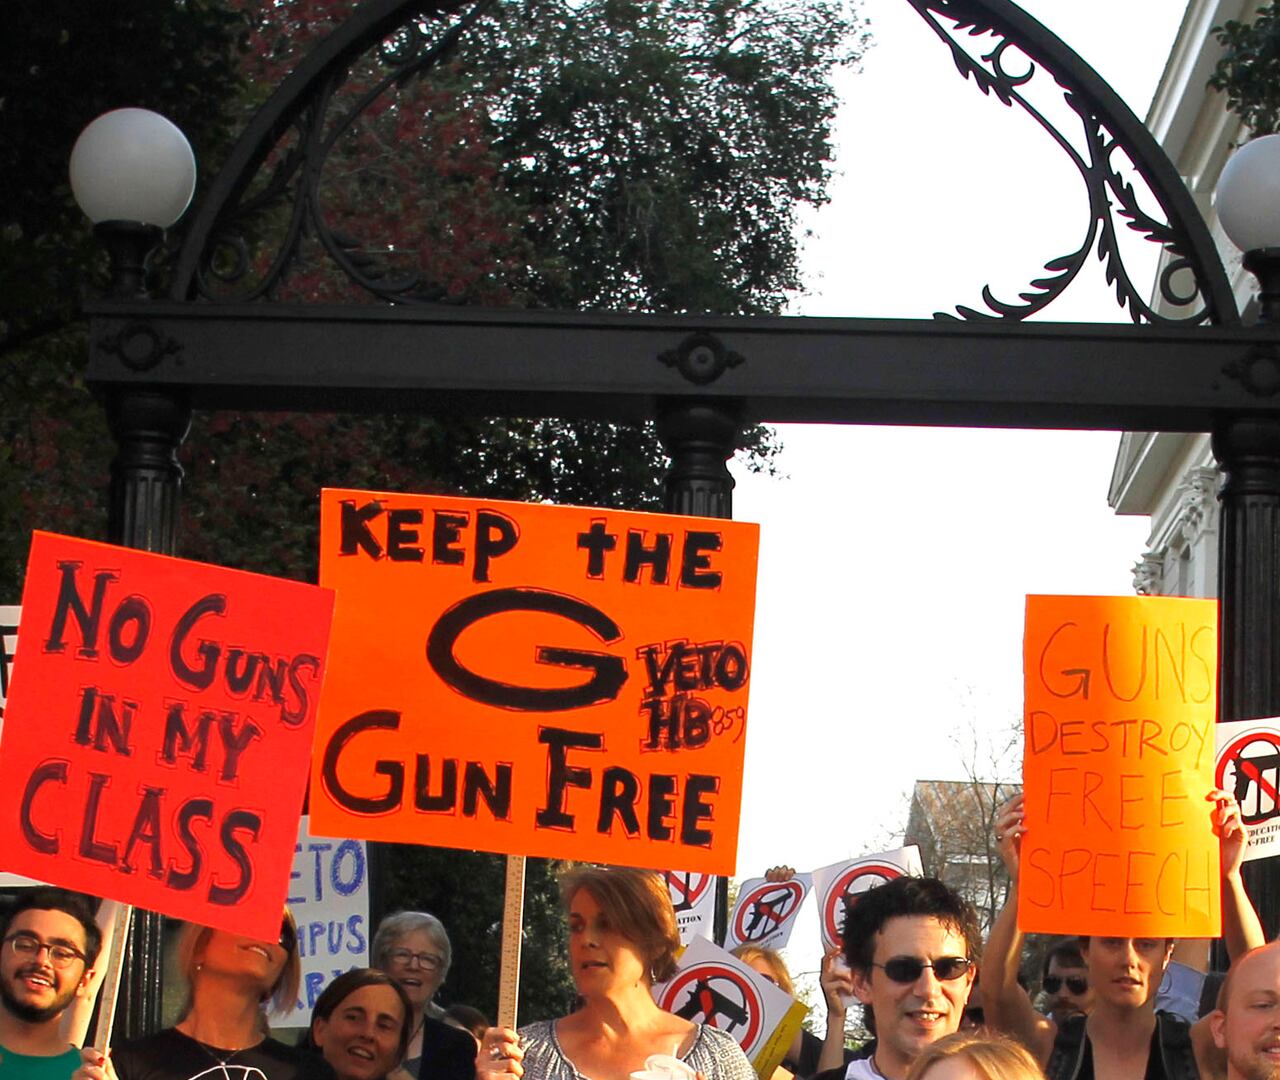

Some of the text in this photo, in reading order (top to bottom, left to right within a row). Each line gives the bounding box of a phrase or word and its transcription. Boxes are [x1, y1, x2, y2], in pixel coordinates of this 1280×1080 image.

[339, 501, 520, 583] KEEP
[42, 560, 320, 728] NO GUNS
[426, 587, 629, 712] G
[635, 638, 750, 693] VETO
[1040, 622, 1213, 704] GUNS
[72, 684, 263, 788] IN MY
[1030, 711, 1211, 770] DESTROY
[321, 711, 720, 849] GUN FREE
[1046, 768, 1189, 831] FREE
[20, 758, 265, 906] CLASS
[1027, 848, 1211, 923] SPEECH
